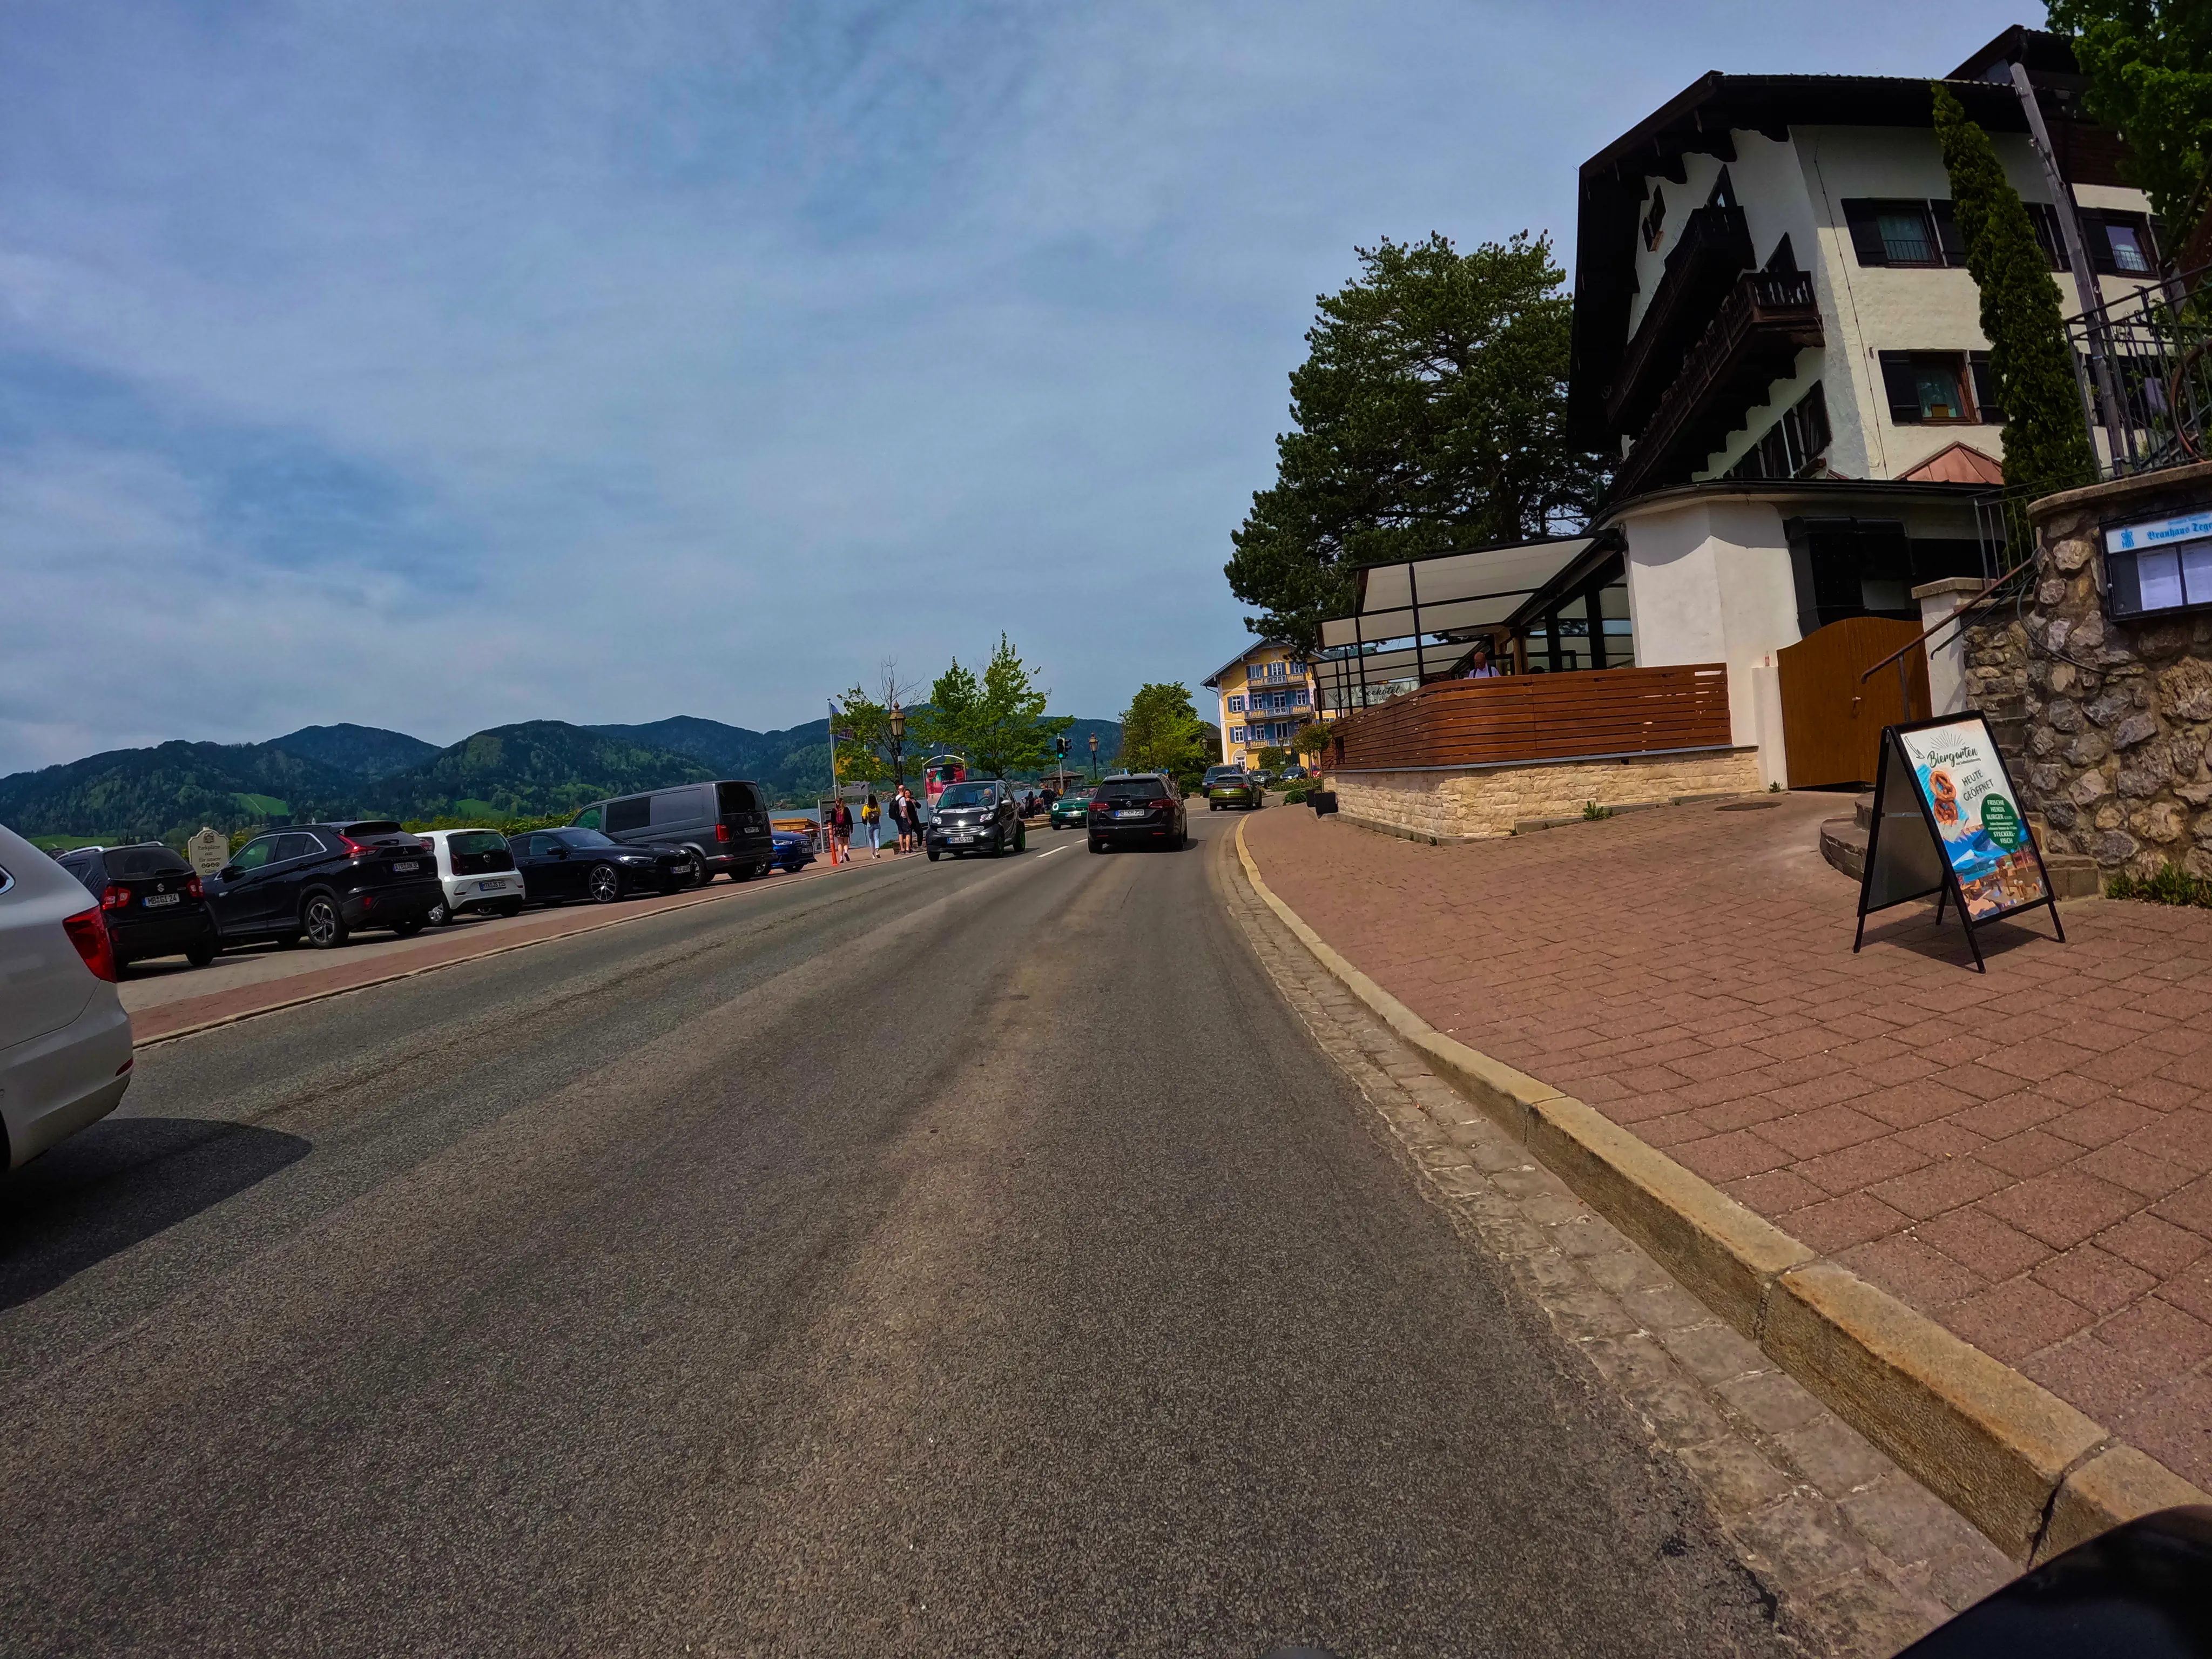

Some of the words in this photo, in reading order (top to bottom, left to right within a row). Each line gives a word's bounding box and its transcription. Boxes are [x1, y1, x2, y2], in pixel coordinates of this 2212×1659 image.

[2147, 526, 2190, 540] Brauhaus
[1927, 746, 1978, 768] Biergarten
[1961, 769, 1984, 787] HEUTE
[1963, 778, 1994, 801] GEÖFFNET
